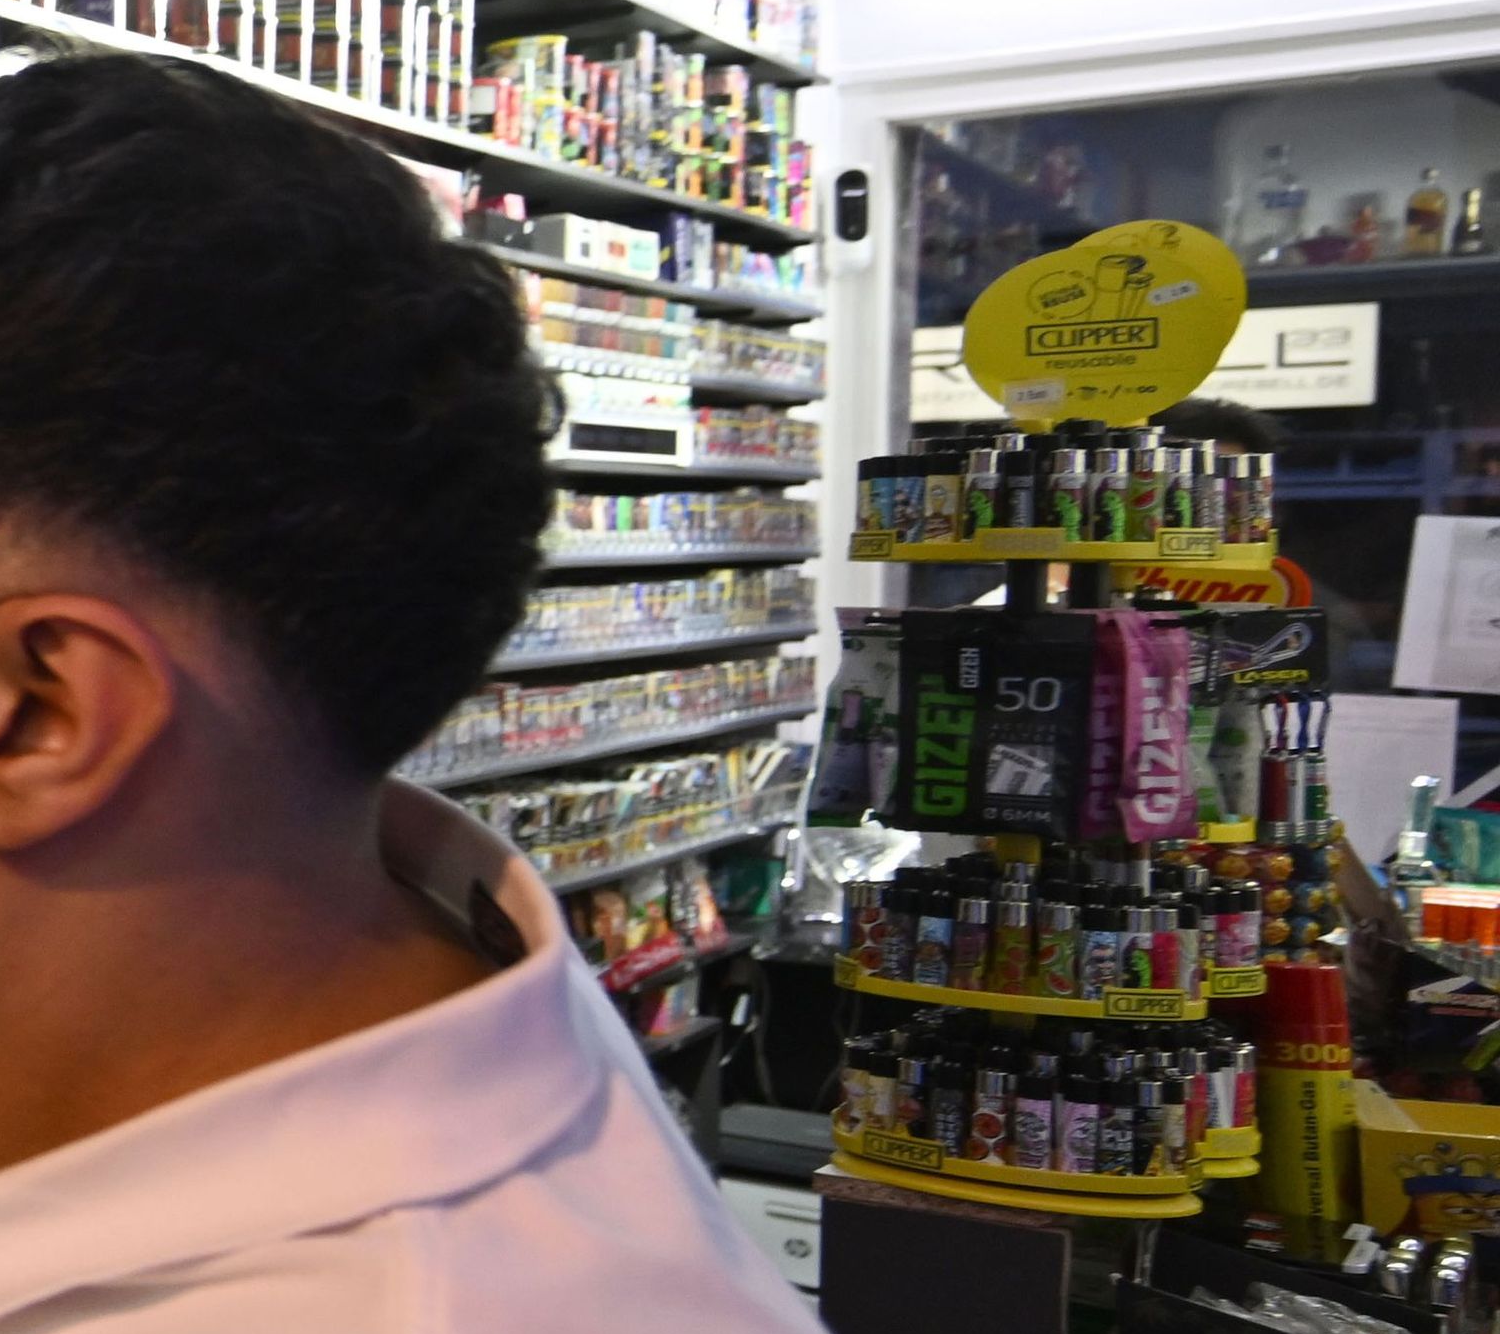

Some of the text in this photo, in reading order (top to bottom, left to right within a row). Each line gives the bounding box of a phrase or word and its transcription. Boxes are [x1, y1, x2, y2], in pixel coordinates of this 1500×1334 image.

[1037, 325, 1147, 349] CLIPPER
[959, 648, 980, 689] GIZEH
[994, 677, 1063, 713] 50
[1112, 996, 1182, 1015] CLIPPER
[871, 1136, 939, 1166] CLIPPER
